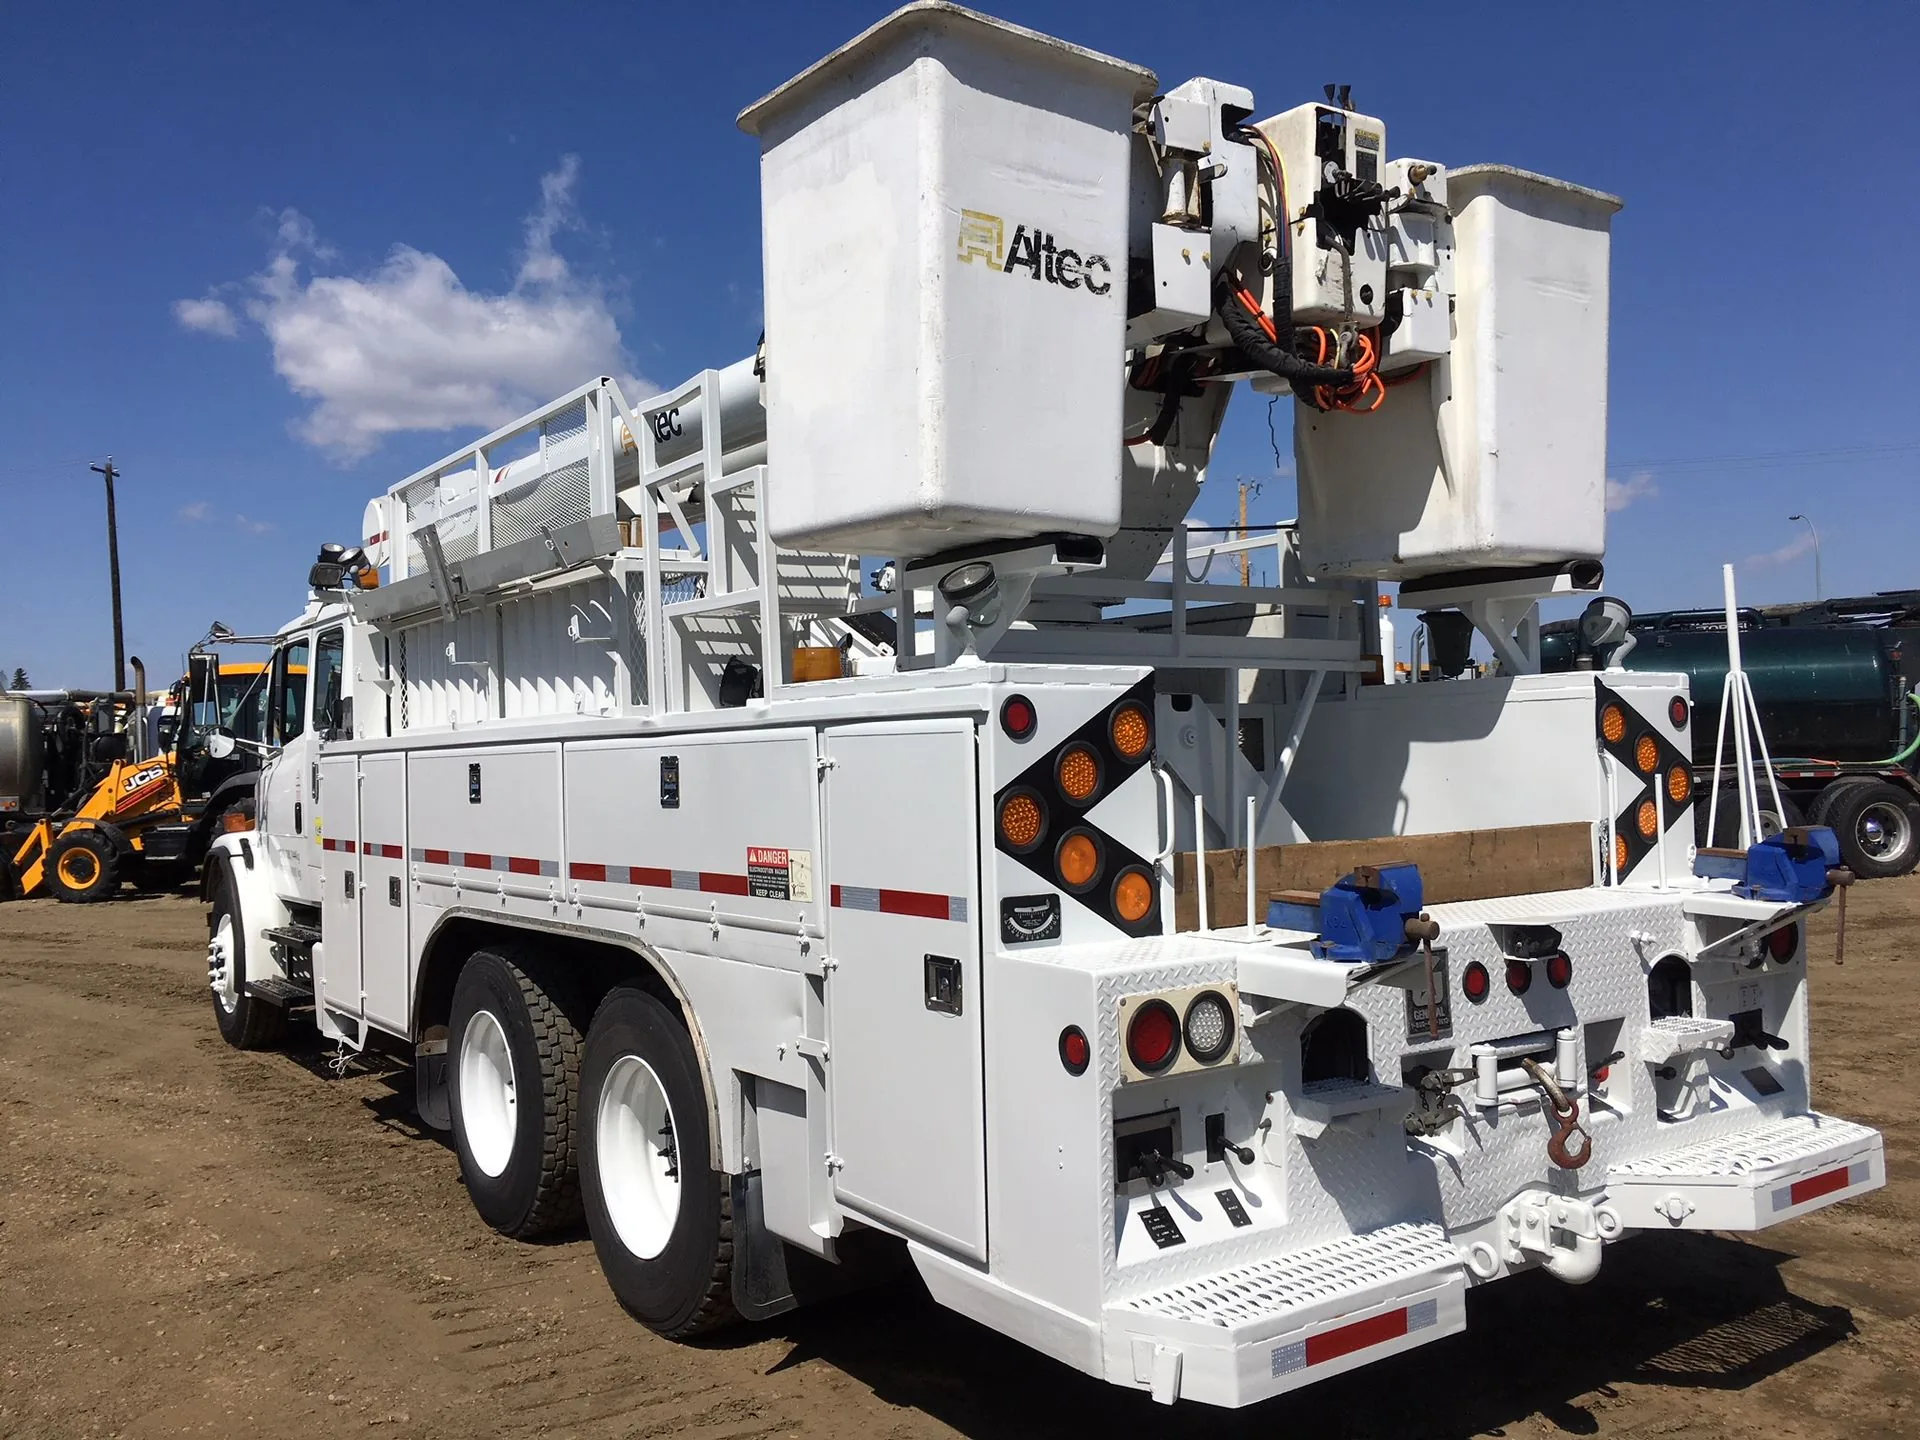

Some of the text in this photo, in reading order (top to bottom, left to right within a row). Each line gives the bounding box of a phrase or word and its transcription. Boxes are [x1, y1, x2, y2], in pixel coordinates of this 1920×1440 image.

[1003, 224, 1111, 295] Altec
[125, 764, 164, 791] JCB
[758, 849, 788, 865] DANGER
[756, 889, 785, 899] KEEP CLEAR
